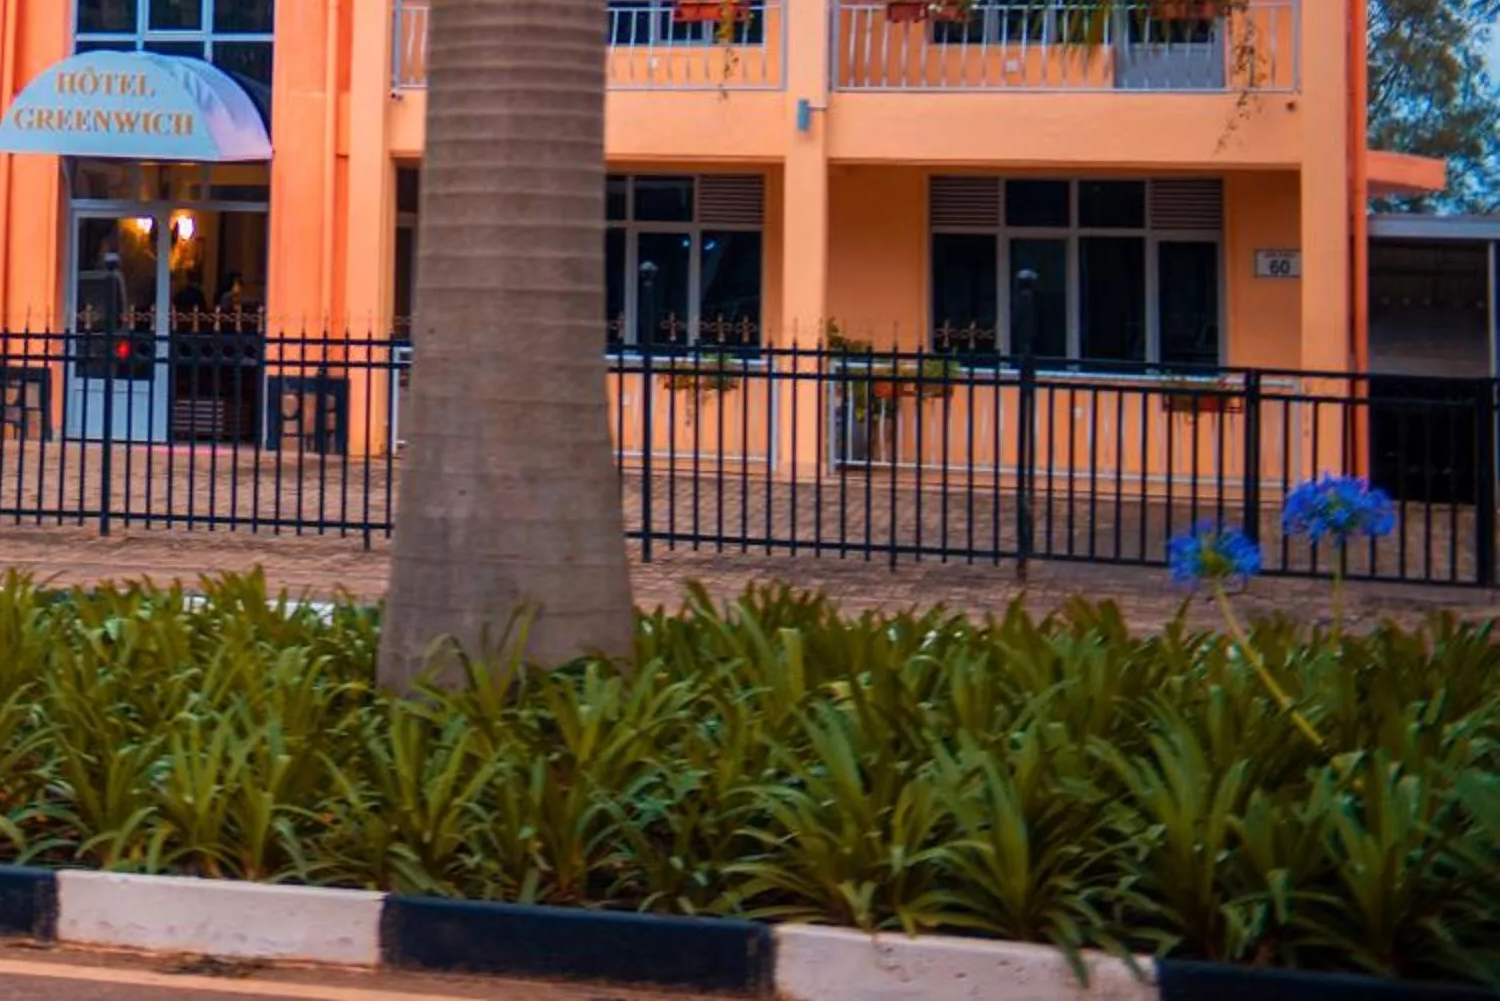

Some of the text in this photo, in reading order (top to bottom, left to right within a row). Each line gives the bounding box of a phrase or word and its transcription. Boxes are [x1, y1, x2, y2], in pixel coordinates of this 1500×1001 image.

[57, 67, 155, 98] HÔTEL
[13, 107, 193, 136] GREENWICH
[1269, 259, 1291, 275] 60
